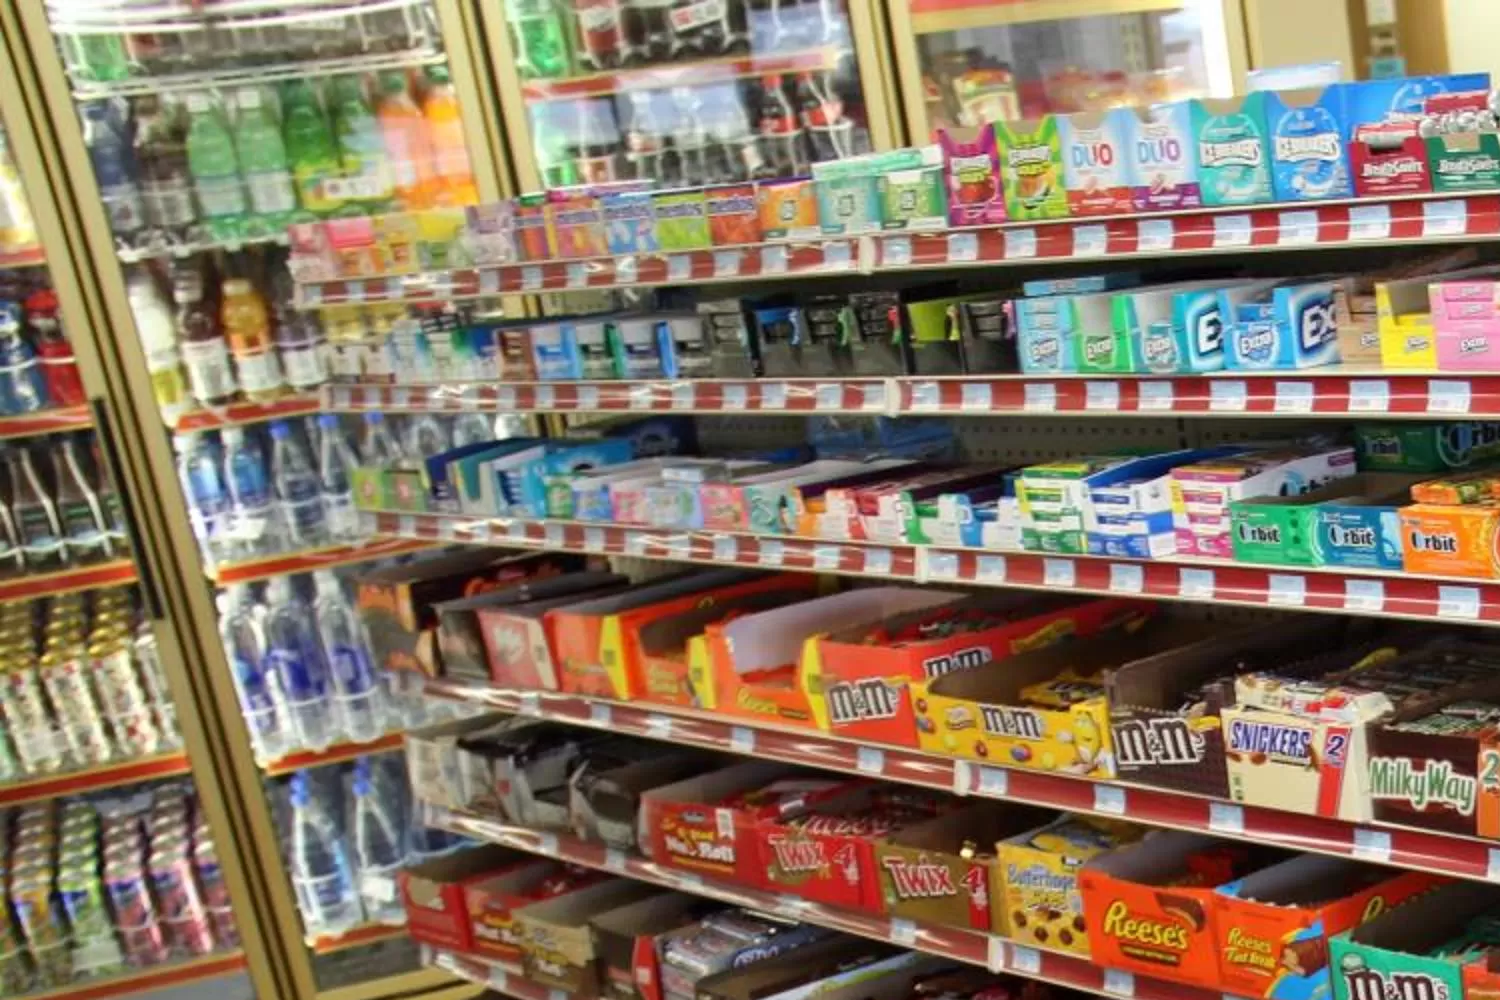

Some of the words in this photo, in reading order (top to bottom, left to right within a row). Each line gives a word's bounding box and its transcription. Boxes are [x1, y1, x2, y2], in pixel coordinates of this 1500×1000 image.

[1411, 532, 1457, 553] Orbit
[1229, 719, 1313, 759] SNICKERS
[1326, 736, 1346, 758] 2
[1482, 752, 1500, 784] 2
[883, 853, 956, 899] Twix
